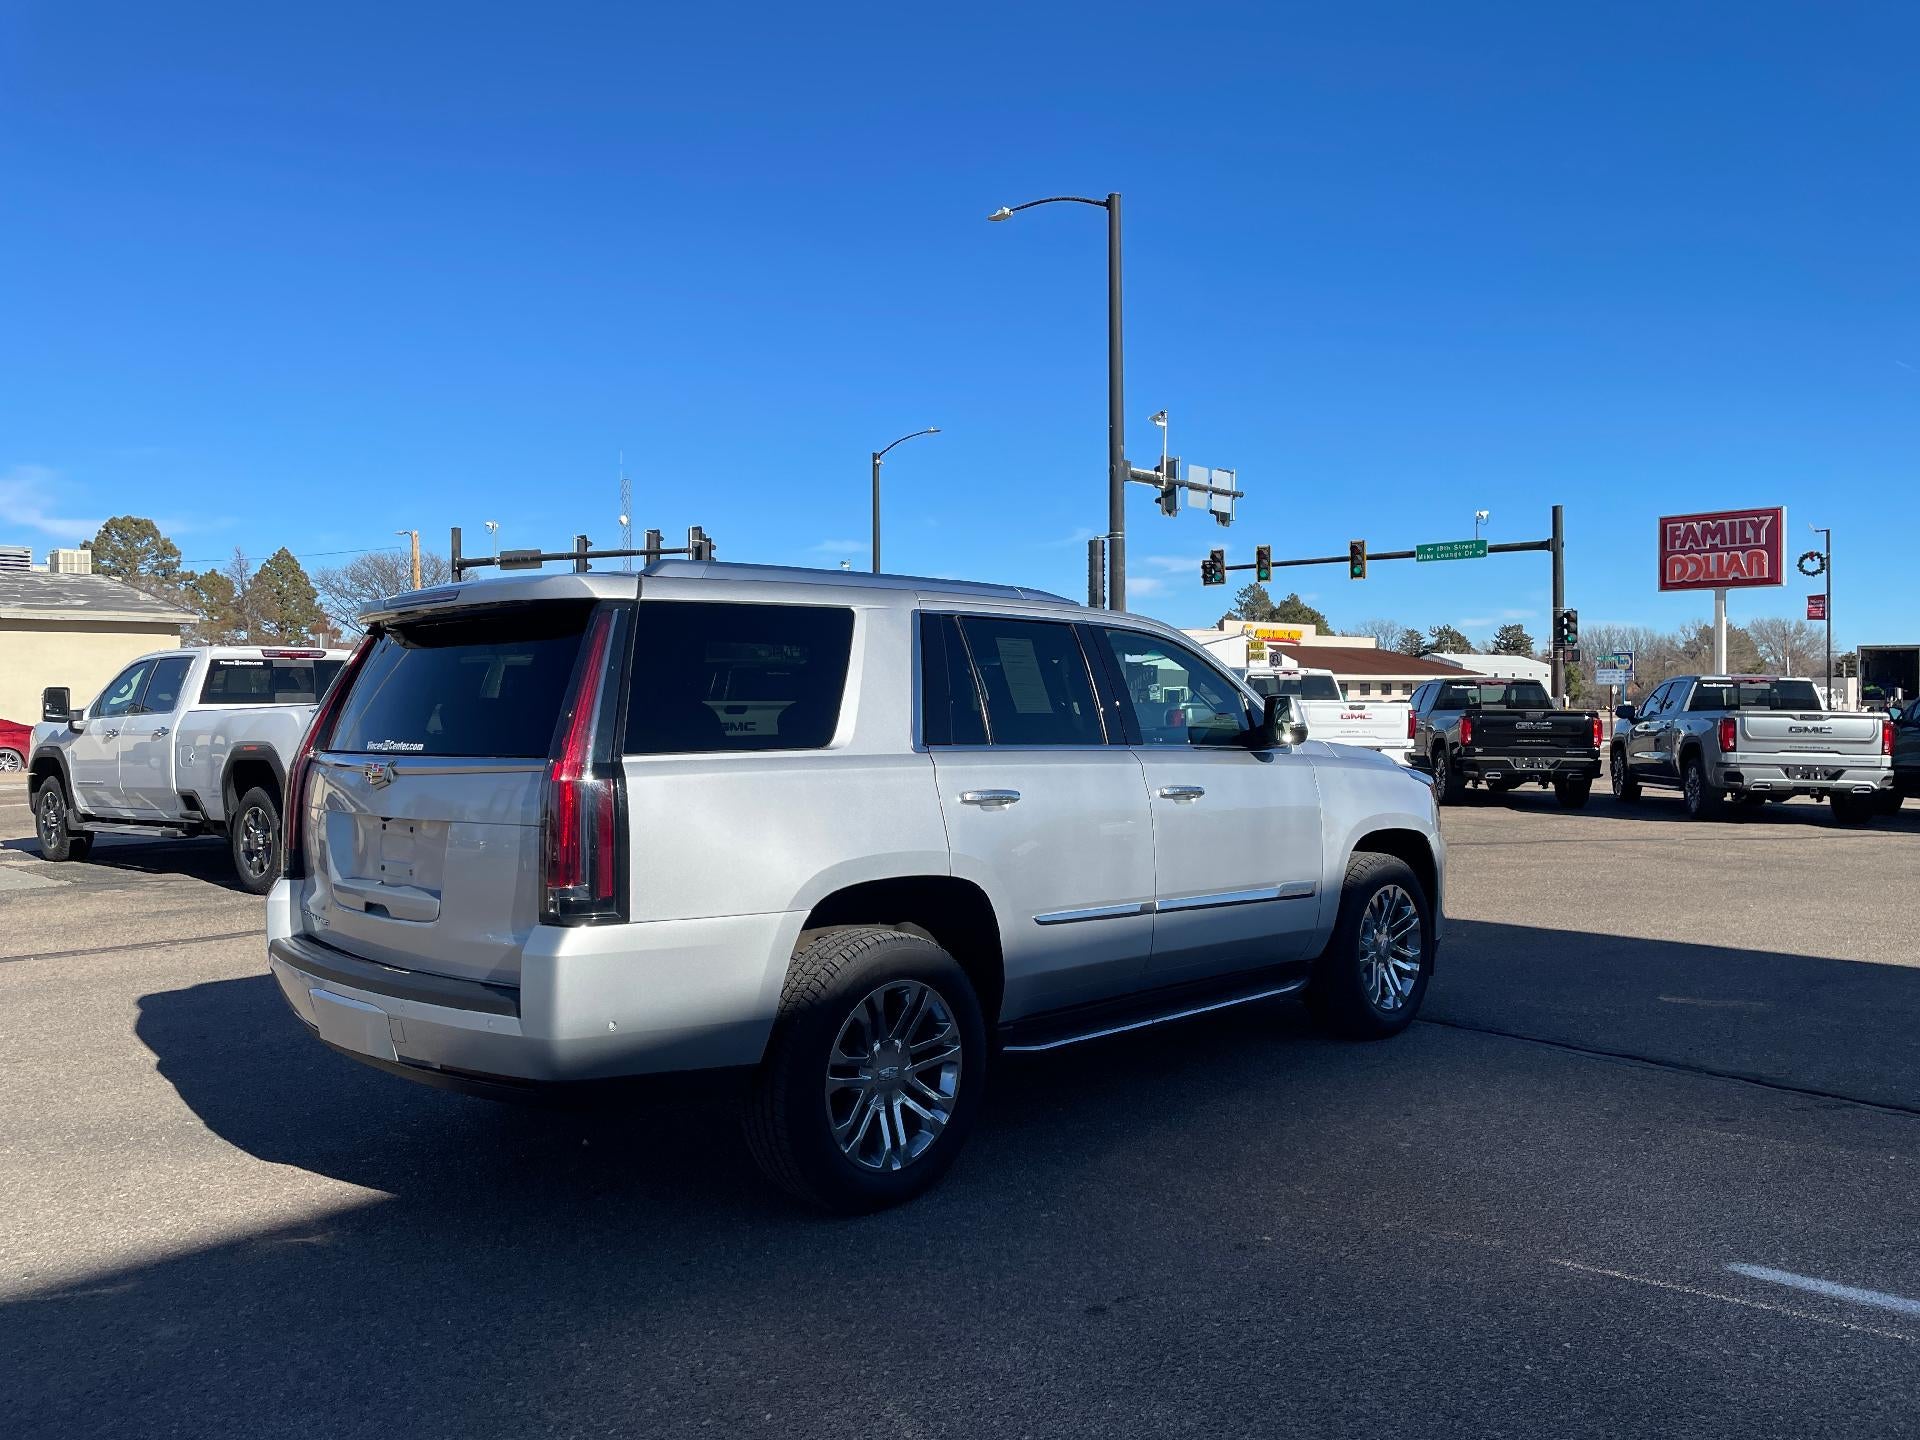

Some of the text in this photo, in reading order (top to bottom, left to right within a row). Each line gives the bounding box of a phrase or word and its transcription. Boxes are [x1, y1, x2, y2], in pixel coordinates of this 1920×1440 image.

[1666, 515, 1774, 551] FAMILY
[1665, 548, 1769, 584] DOLLAR
[1340, 712, 1373, 720] GMC
[1788, 726, 1833, 734] GMC
